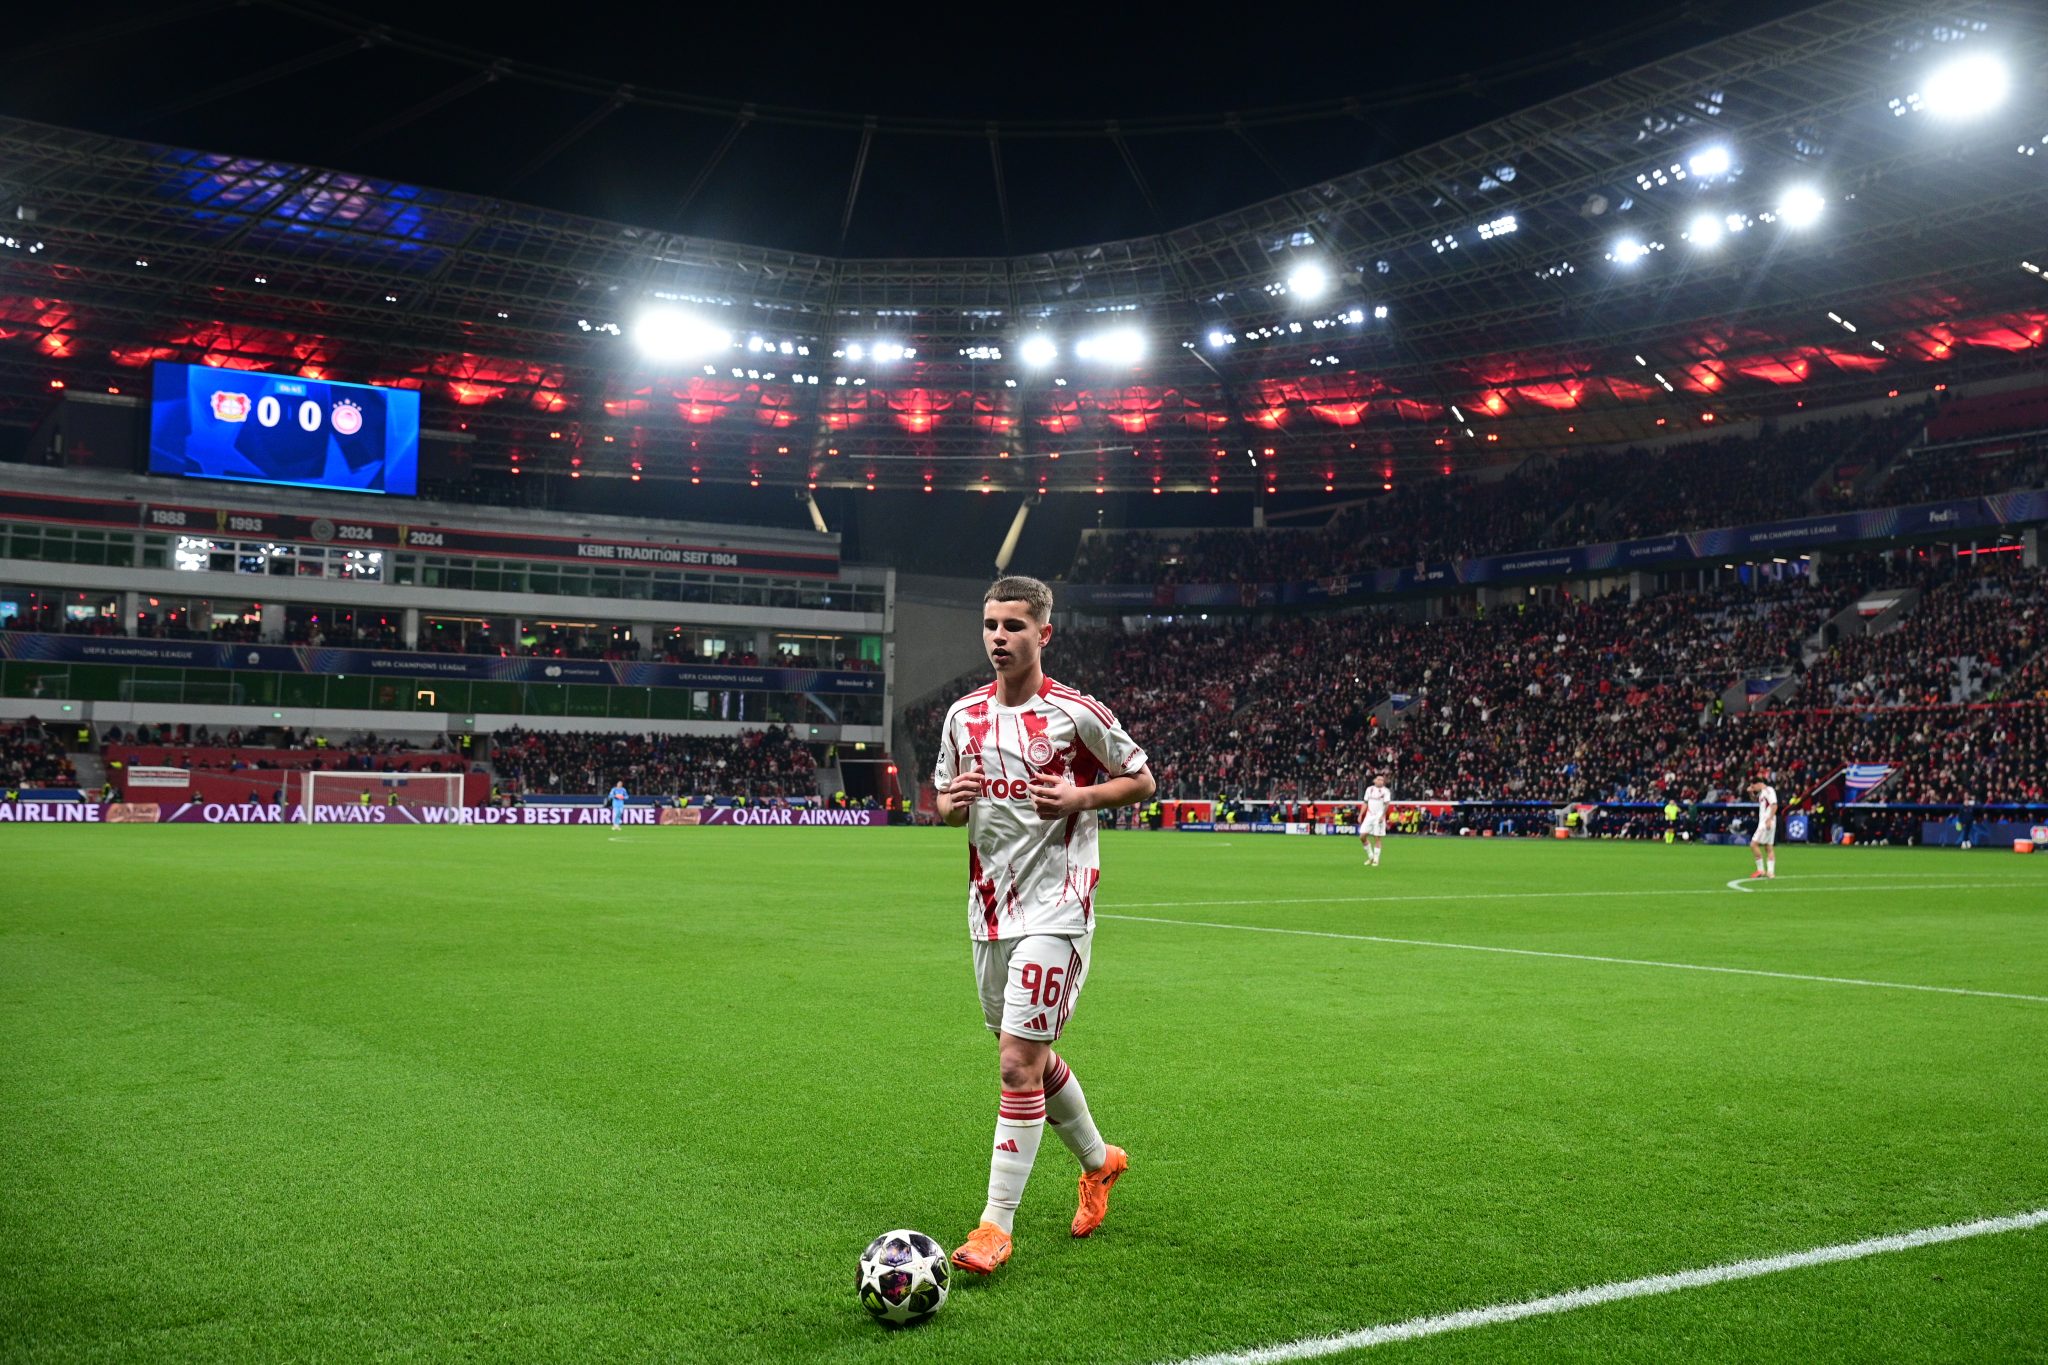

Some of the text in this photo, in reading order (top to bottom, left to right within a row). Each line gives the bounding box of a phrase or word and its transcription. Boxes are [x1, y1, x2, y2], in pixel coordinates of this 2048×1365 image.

[257, 395, 322, 431] 0 0
[152, 510, 186, 525] 1988
[230, 516, 263, 532] 1993
[339, 525, 373, 540] 2024
[410, 531, 443, 546] 2024
[1769, 528, 1808, 539] CHAMPIONS
[1810, 525, 1837, 535] LEAGUE
[578, 543, 614, 558] KEINE
[683, 551, 709, 564] SEIT
[711, 553, 738, 566] 1904
[393, 661, 437, 669] CHAMPIONS
[698, 674, 737, 682] CHAMPIONS
[980, 778, 1044, 800] roe
[0, 803, 100, 822] AIRLINE
[203, 803, 386, 823] QATAR ARWAYS
[422, 806, 518, 824] WORLD'S
[523, 807, 573, 824] BEST
[733, 808, 870, 826] QATAR AIRWAYS
[1021, 963, 1064, 1007] 96
